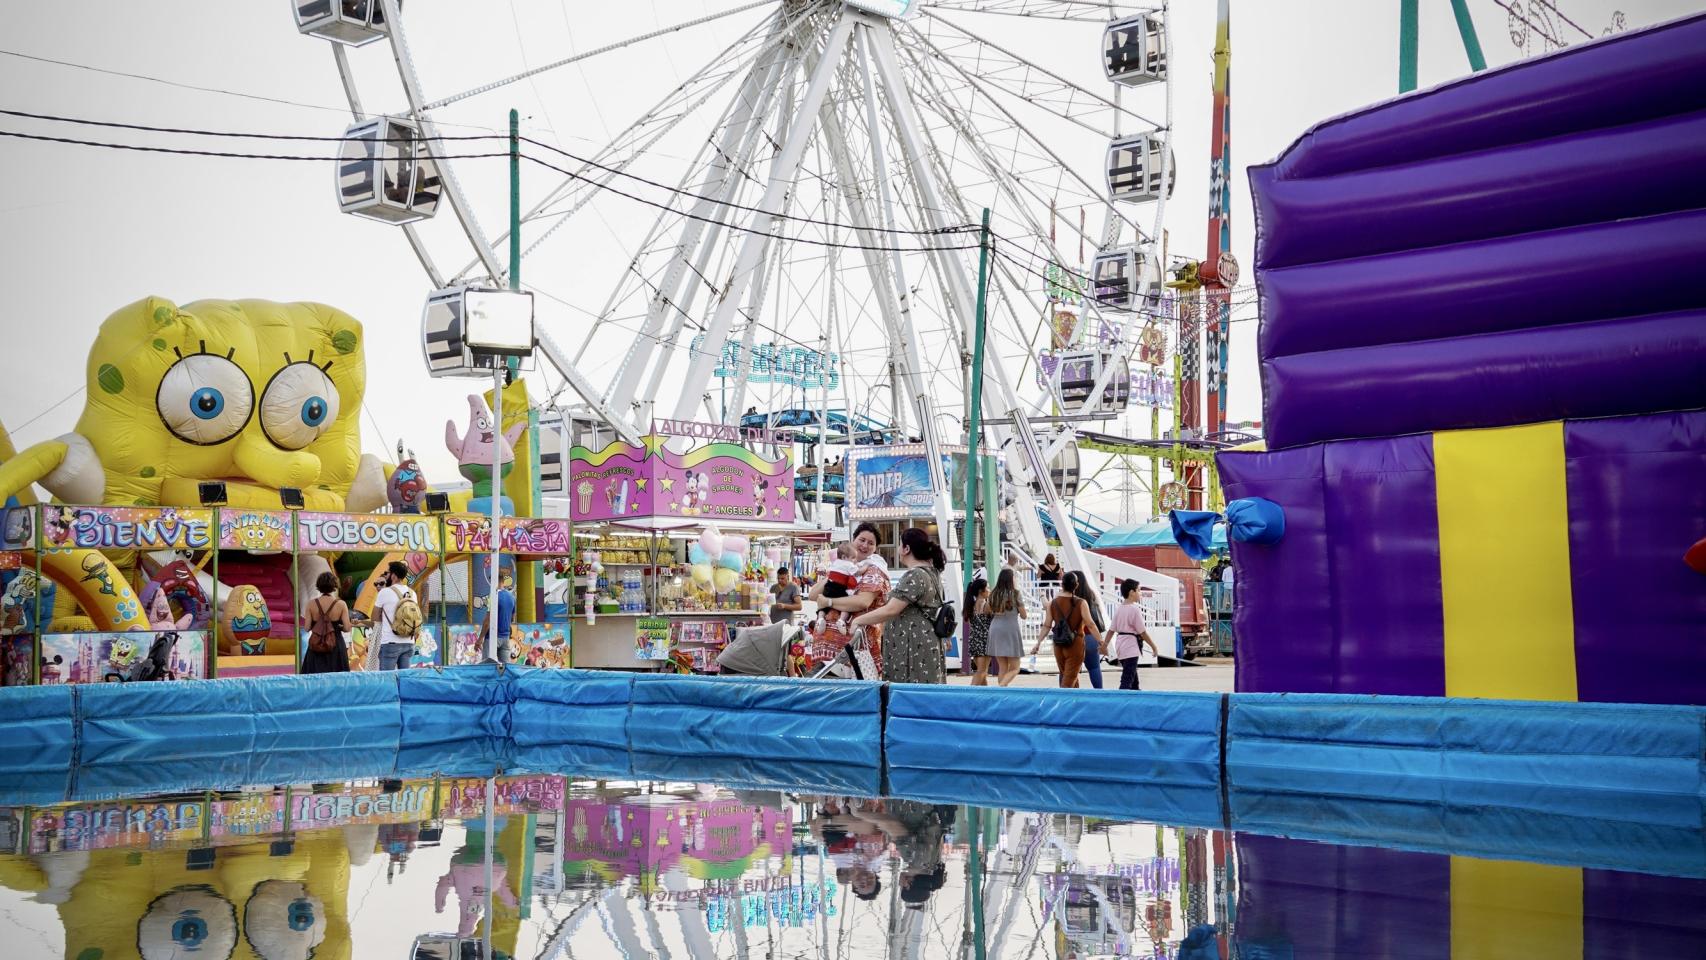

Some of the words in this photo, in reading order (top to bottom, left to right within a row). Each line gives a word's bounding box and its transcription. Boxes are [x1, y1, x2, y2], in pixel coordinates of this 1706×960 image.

[660, 419, 741, 441] ALGODON
[712, 465, 745, 477] ALGODON
[723, 475, 733, 483] DE
[860, 472, 902, 500] NORIA
[715, 505, 753, 516] ANGELES
[220, 514, 290, 540] ENTRADA
[300, 519, 435, 551] TOBOGAN
